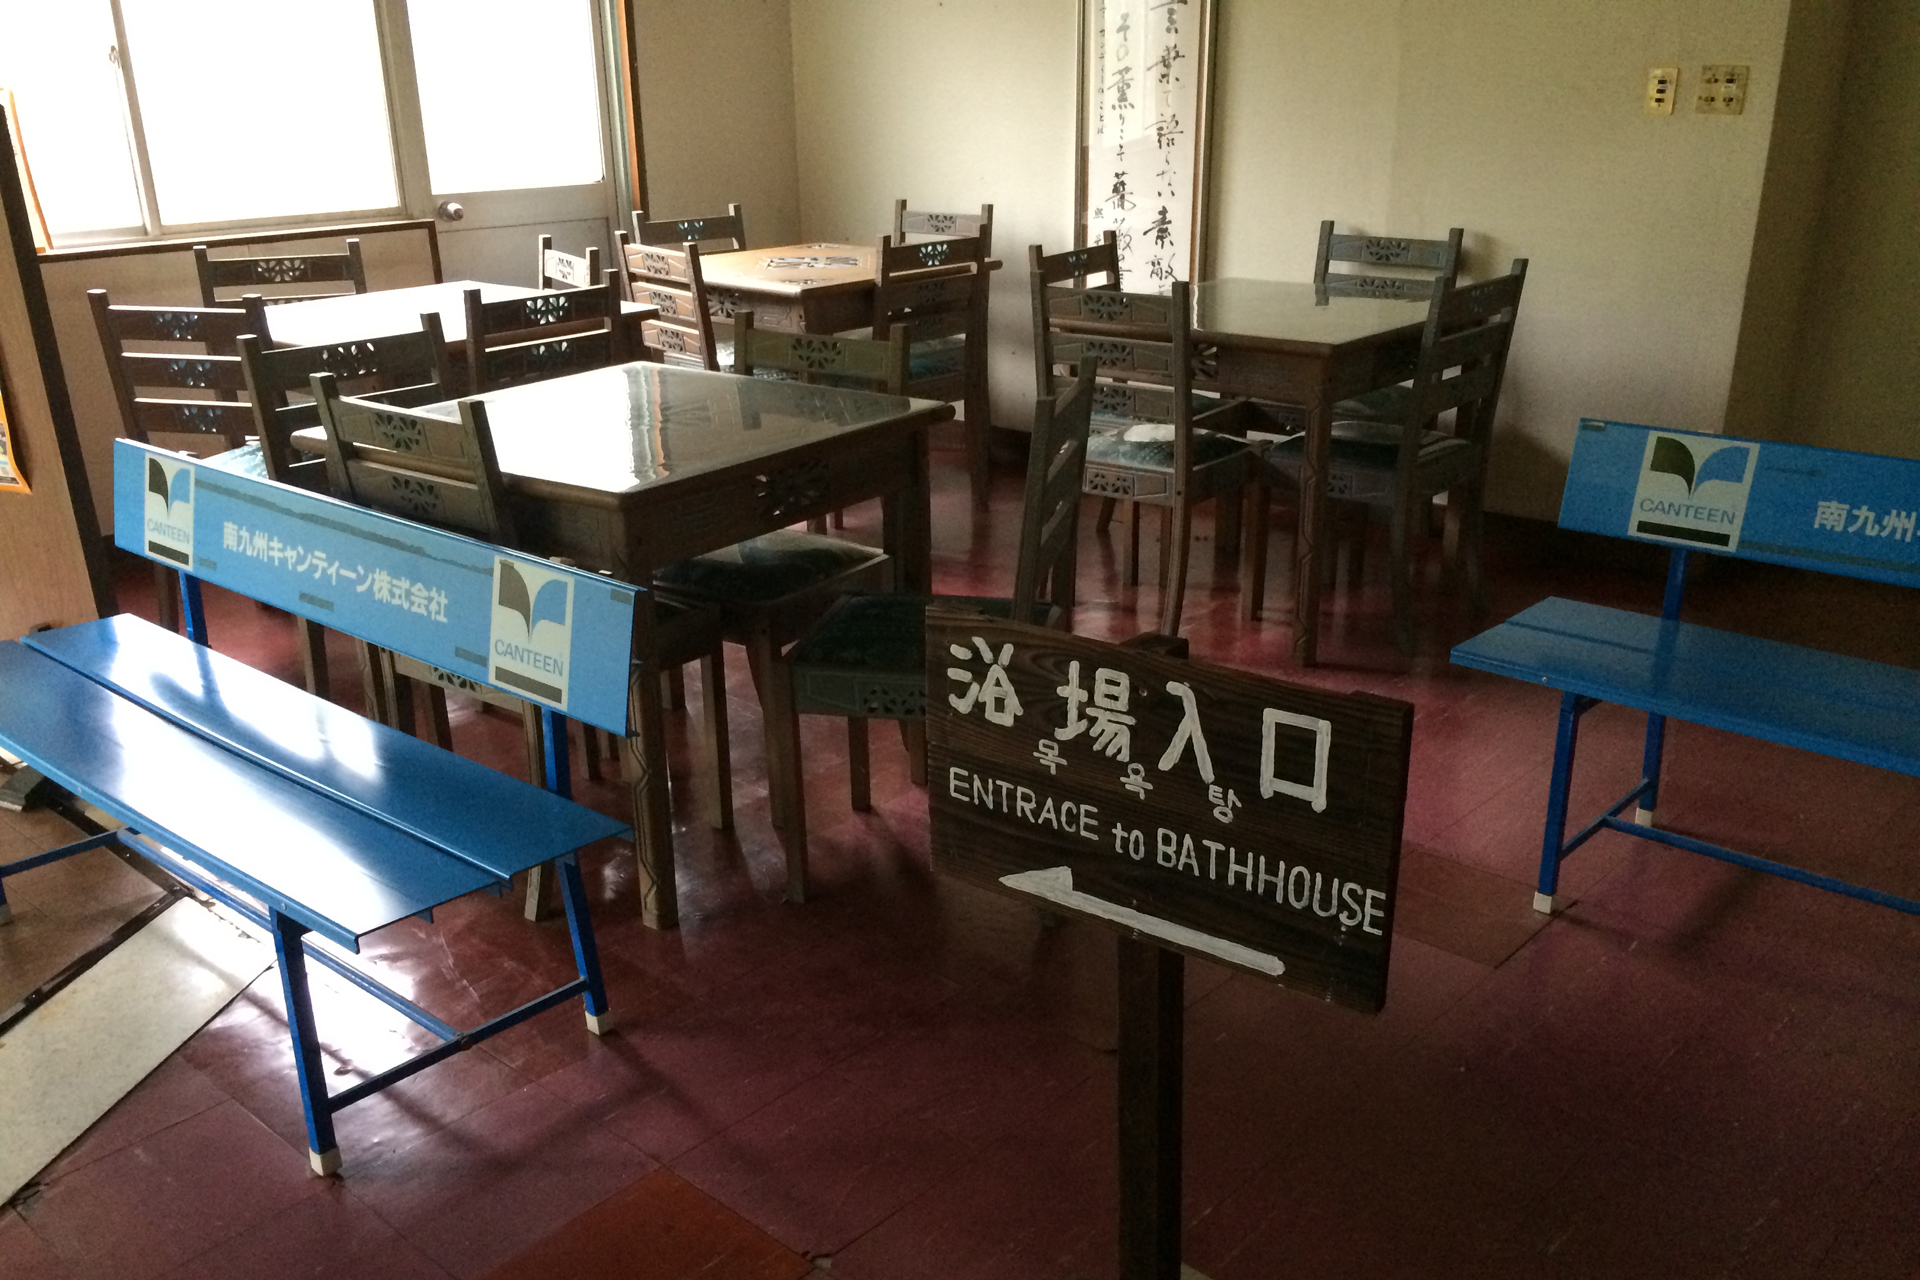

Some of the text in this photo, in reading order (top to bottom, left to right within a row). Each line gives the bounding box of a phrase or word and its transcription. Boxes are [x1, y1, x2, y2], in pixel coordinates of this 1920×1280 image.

[146, 516, 191, 546] CANTEEN
[1639, 497, 1737, 526] CANTEEN
[1813, 500, 1920, 543] 南九州
[222, 521, 449, 624] 南九州キャンティーン株式会社
[493, 638, 565, 678] CANTEEN
[946, 636, 1332, 813] 浴場入口
[948, 766, 1387, 938] ENTRACE to BATHHOUSE
